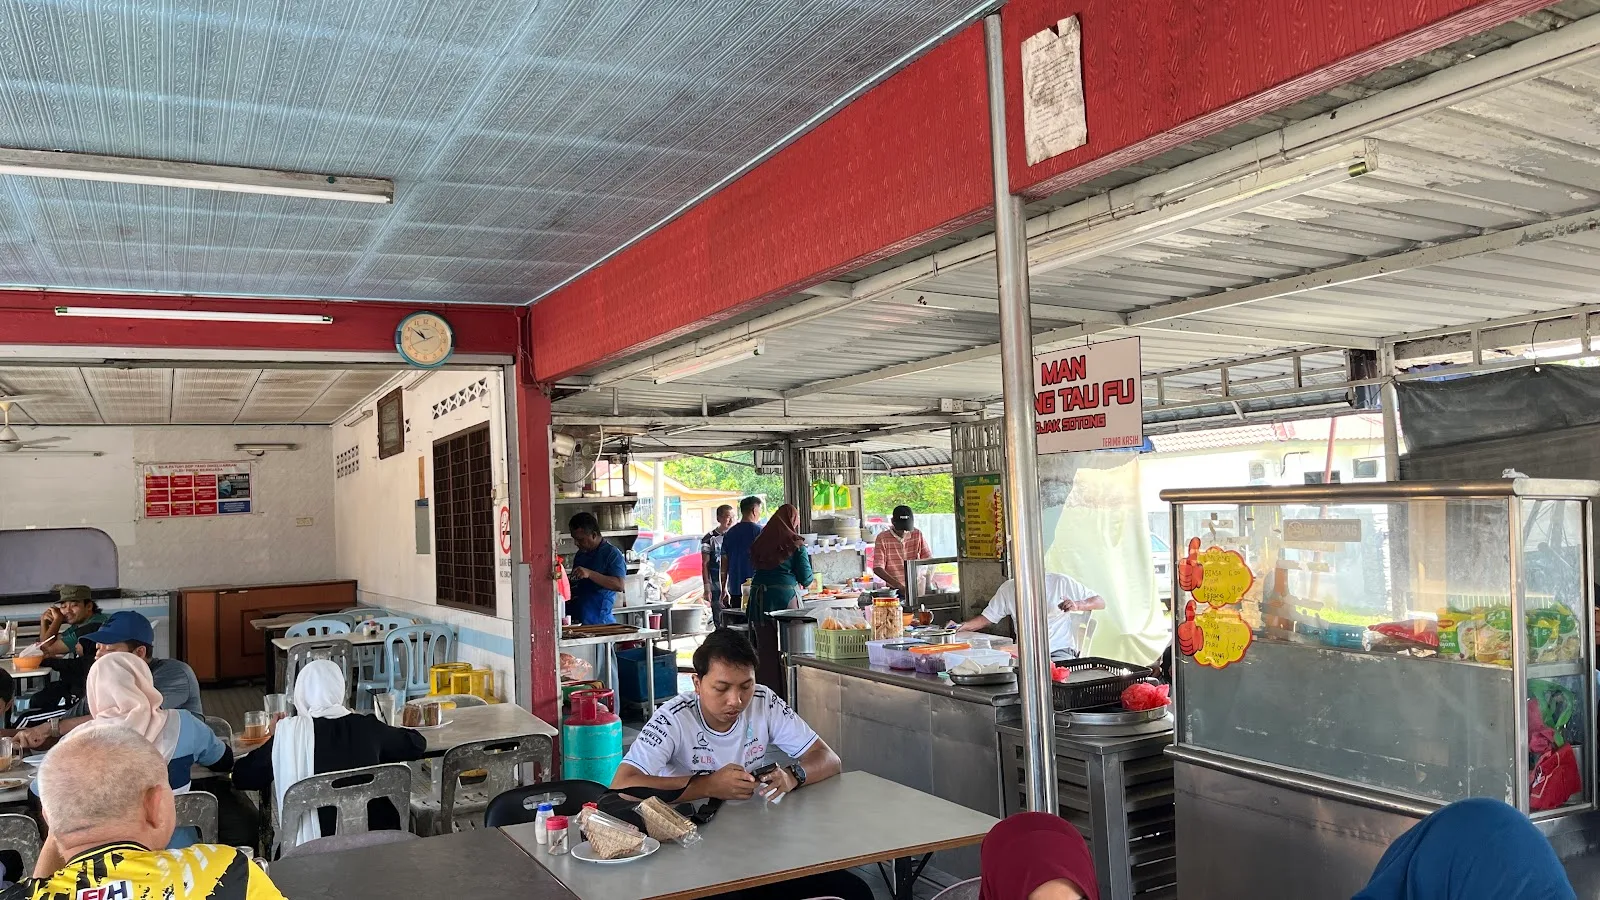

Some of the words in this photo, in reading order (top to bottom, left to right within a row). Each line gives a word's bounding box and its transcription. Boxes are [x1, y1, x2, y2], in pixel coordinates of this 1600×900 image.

[1042, 355, 1086, 385] MAN
[1058, 383, 1099, 412] TAU
[1102, 378, 1135, 406] FU
[1062, 413, 1106, 431] SOTONG
[1102, 437, 1121, 447] TERIMA
[1122, 435, 1139, 445] KASIH
